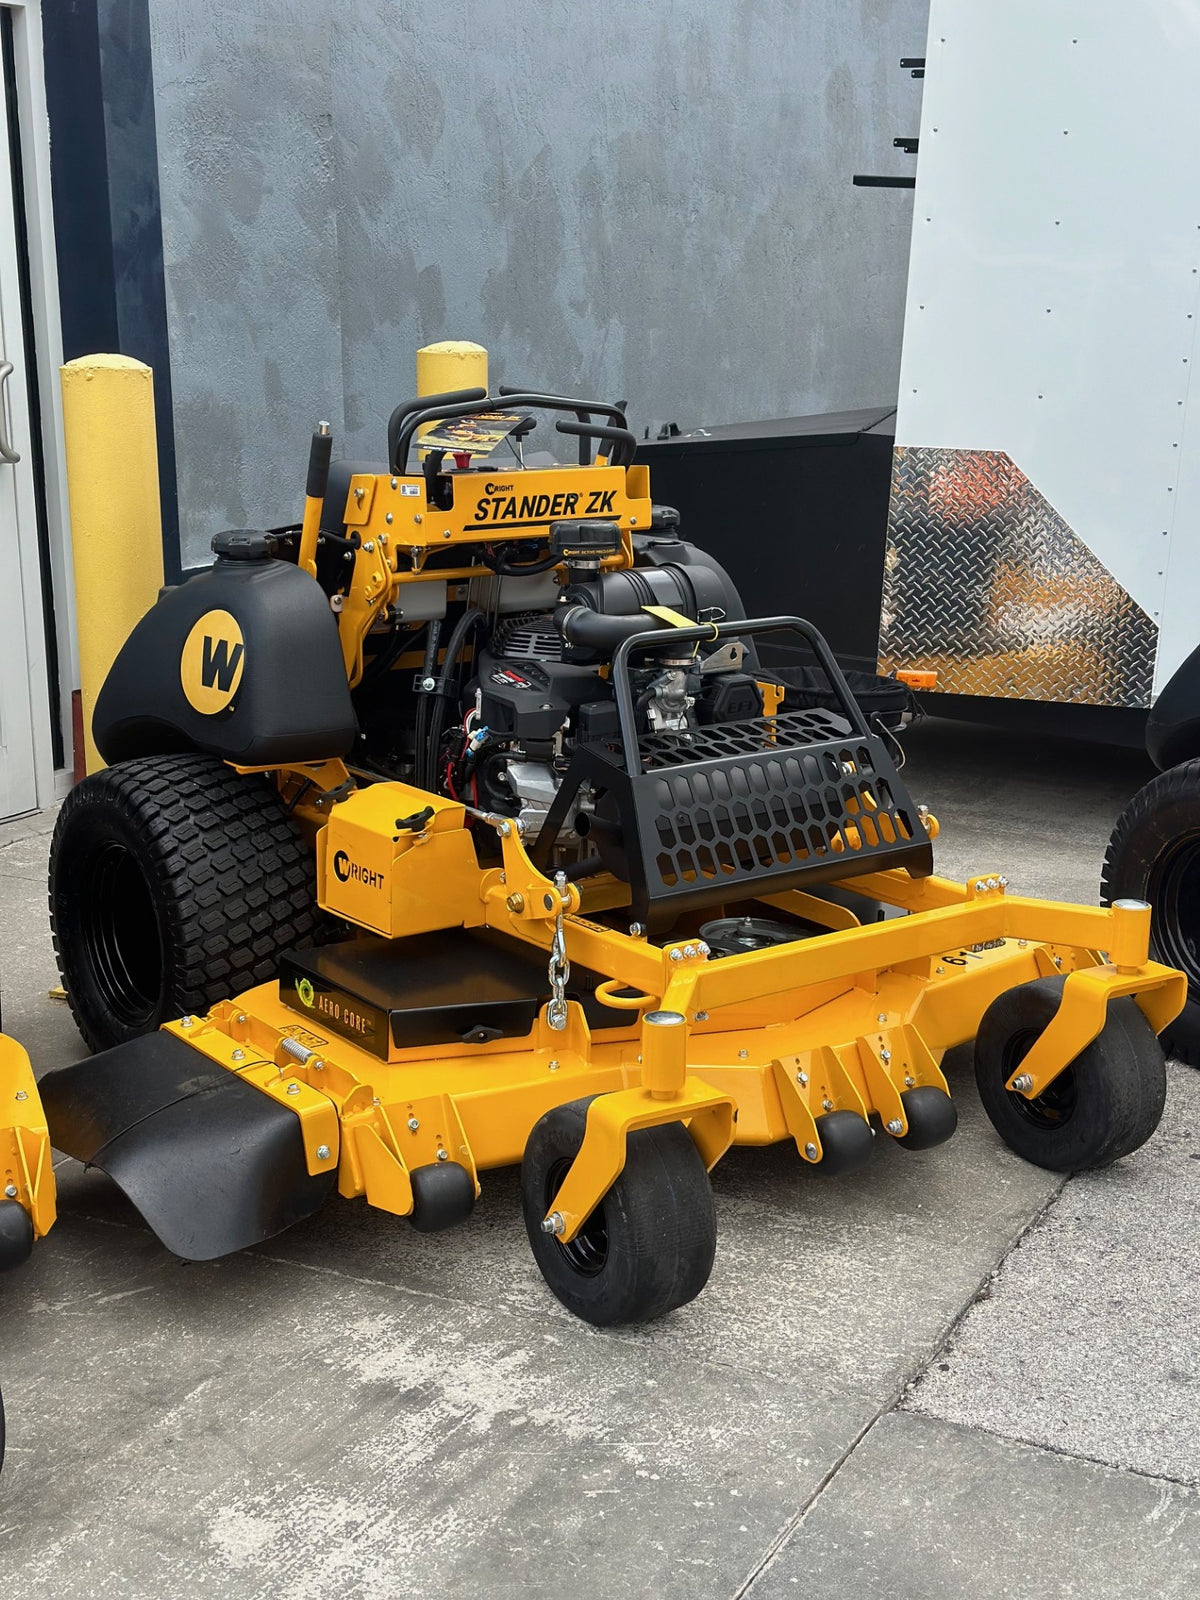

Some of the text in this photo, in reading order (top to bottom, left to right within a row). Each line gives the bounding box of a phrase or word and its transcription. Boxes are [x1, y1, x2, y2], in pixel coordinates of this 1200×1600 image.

[485, 483, 514, 495] WRIGHT
[585, 490, 618, 514] ZK
[202, 635, 244, 692] W
[334, 850, 384, 890] WRIGHT
[319, 995, 340, 1020] AERO
